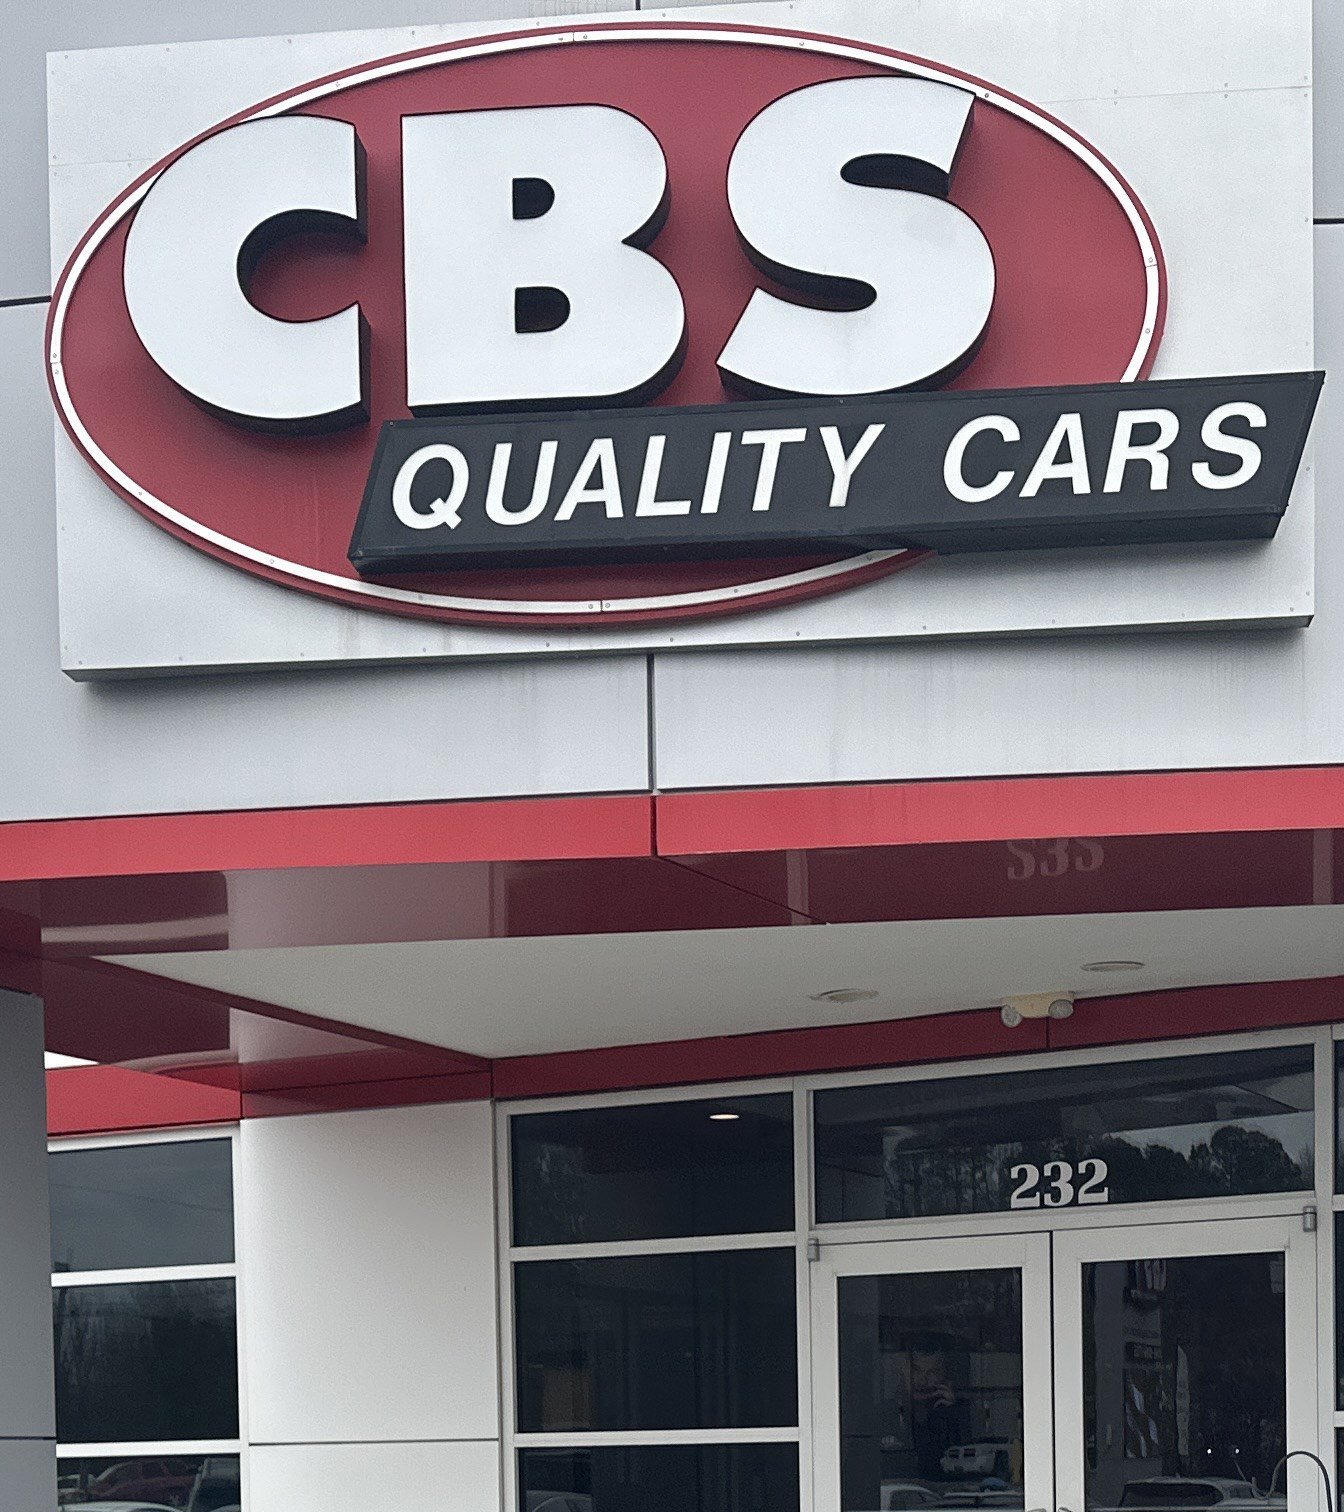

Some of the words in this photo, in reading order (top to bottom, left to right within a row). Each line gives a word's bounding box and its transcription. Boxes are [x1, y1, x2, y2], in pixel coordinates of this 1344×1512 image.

[122, 76, 996, 420] CBS
[392, 423, 886, 530] QUALITY
[943, 401, 1267, 503] CARS
[1009, 1158, 1110, 1209] 232
